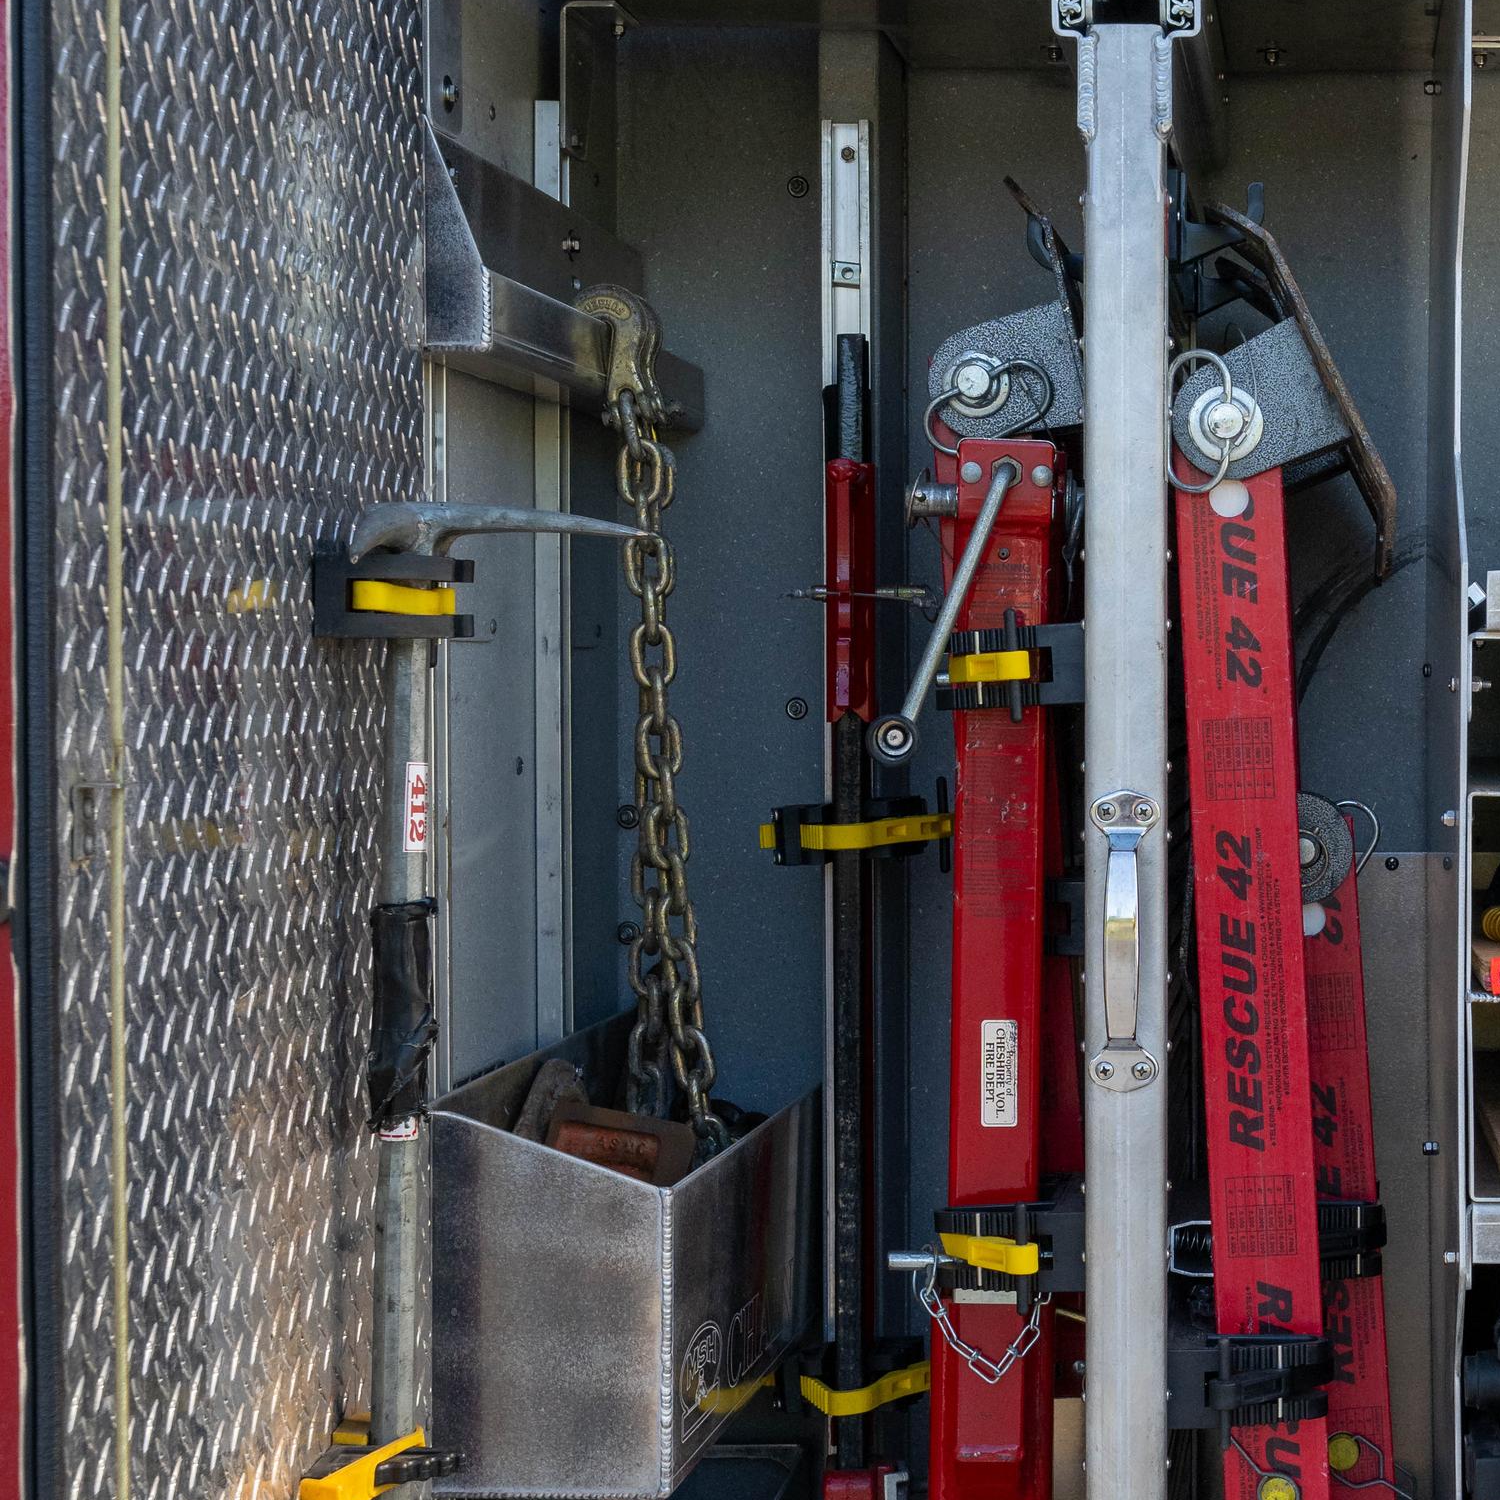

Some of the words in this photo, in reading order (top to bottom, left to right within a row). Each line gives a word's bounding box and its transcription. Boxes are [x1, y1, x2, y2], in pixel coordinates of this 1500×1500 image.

[1226, 616, 1263, 689] 42
[410, 774, 426, 842] 412
[1214, 829, 1253, 902] 42
[986, 1042, 994, 1068] FIRE
[996, 1028, 1006, 1089] CHESHIRE
[1219, 912, 1266, 1153] RESCUE
[986, 1070, 994, 1105] DEPT.
[1004, 1050, 1014, 1086] Property
[1006, 1088, 1014, 1097] of
[996, 1092, 1006, 1119] VOL.
[686, 1327, 718, 1392] MSH
